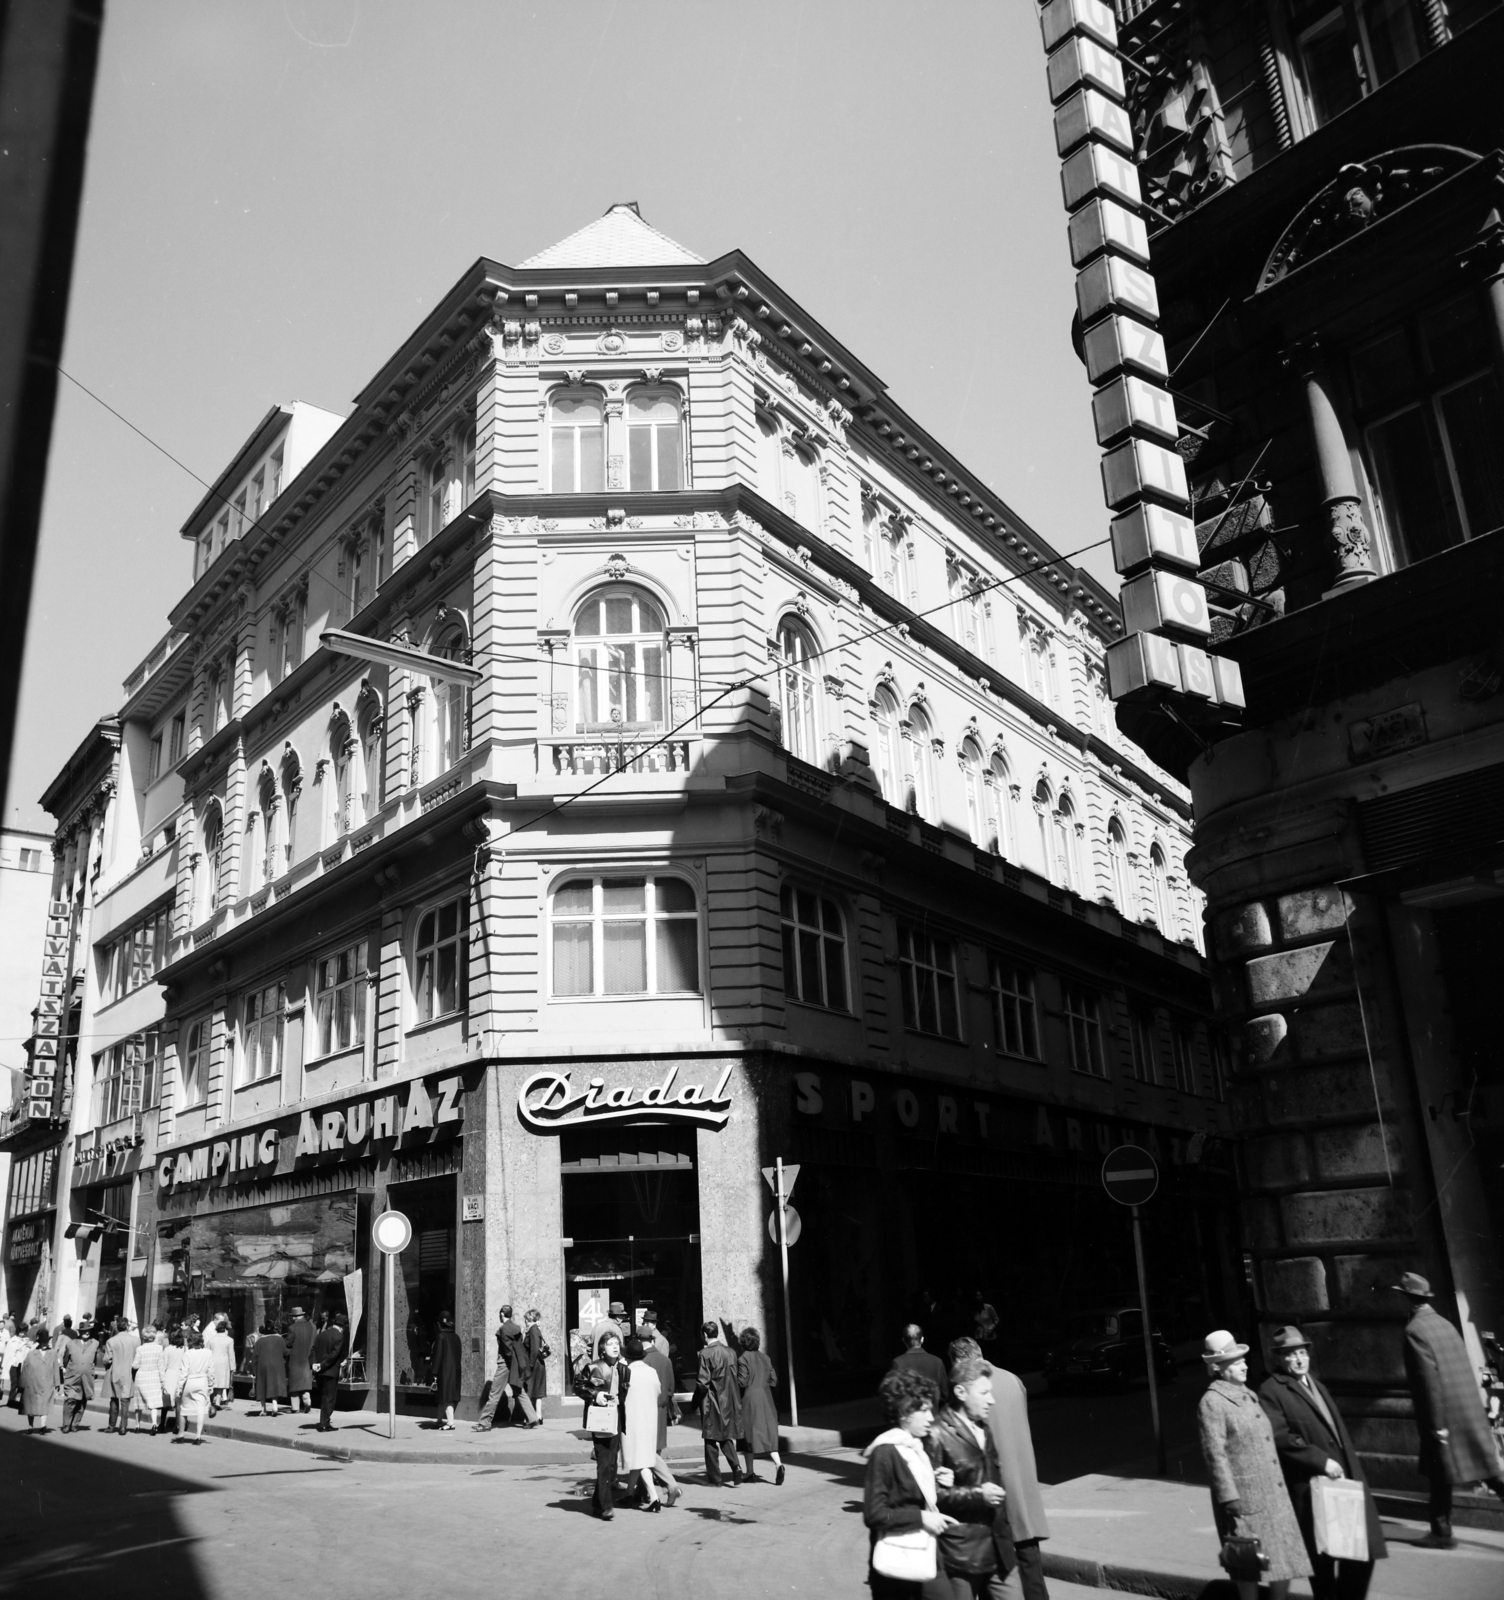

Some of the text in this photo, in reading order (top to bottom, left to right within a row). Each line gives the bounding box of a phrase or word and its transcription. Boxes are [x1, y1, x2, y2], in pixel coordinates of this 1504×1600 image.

[1152, 636, 1245, 707] KSZ
[32, 902, 68, 1117] DIVATSZALON
[519, 1064, 733, 1127] Diadal
[794, 1071, 991, 1139] SPORT
[159, 1129, 280, 1188] CAMPING
